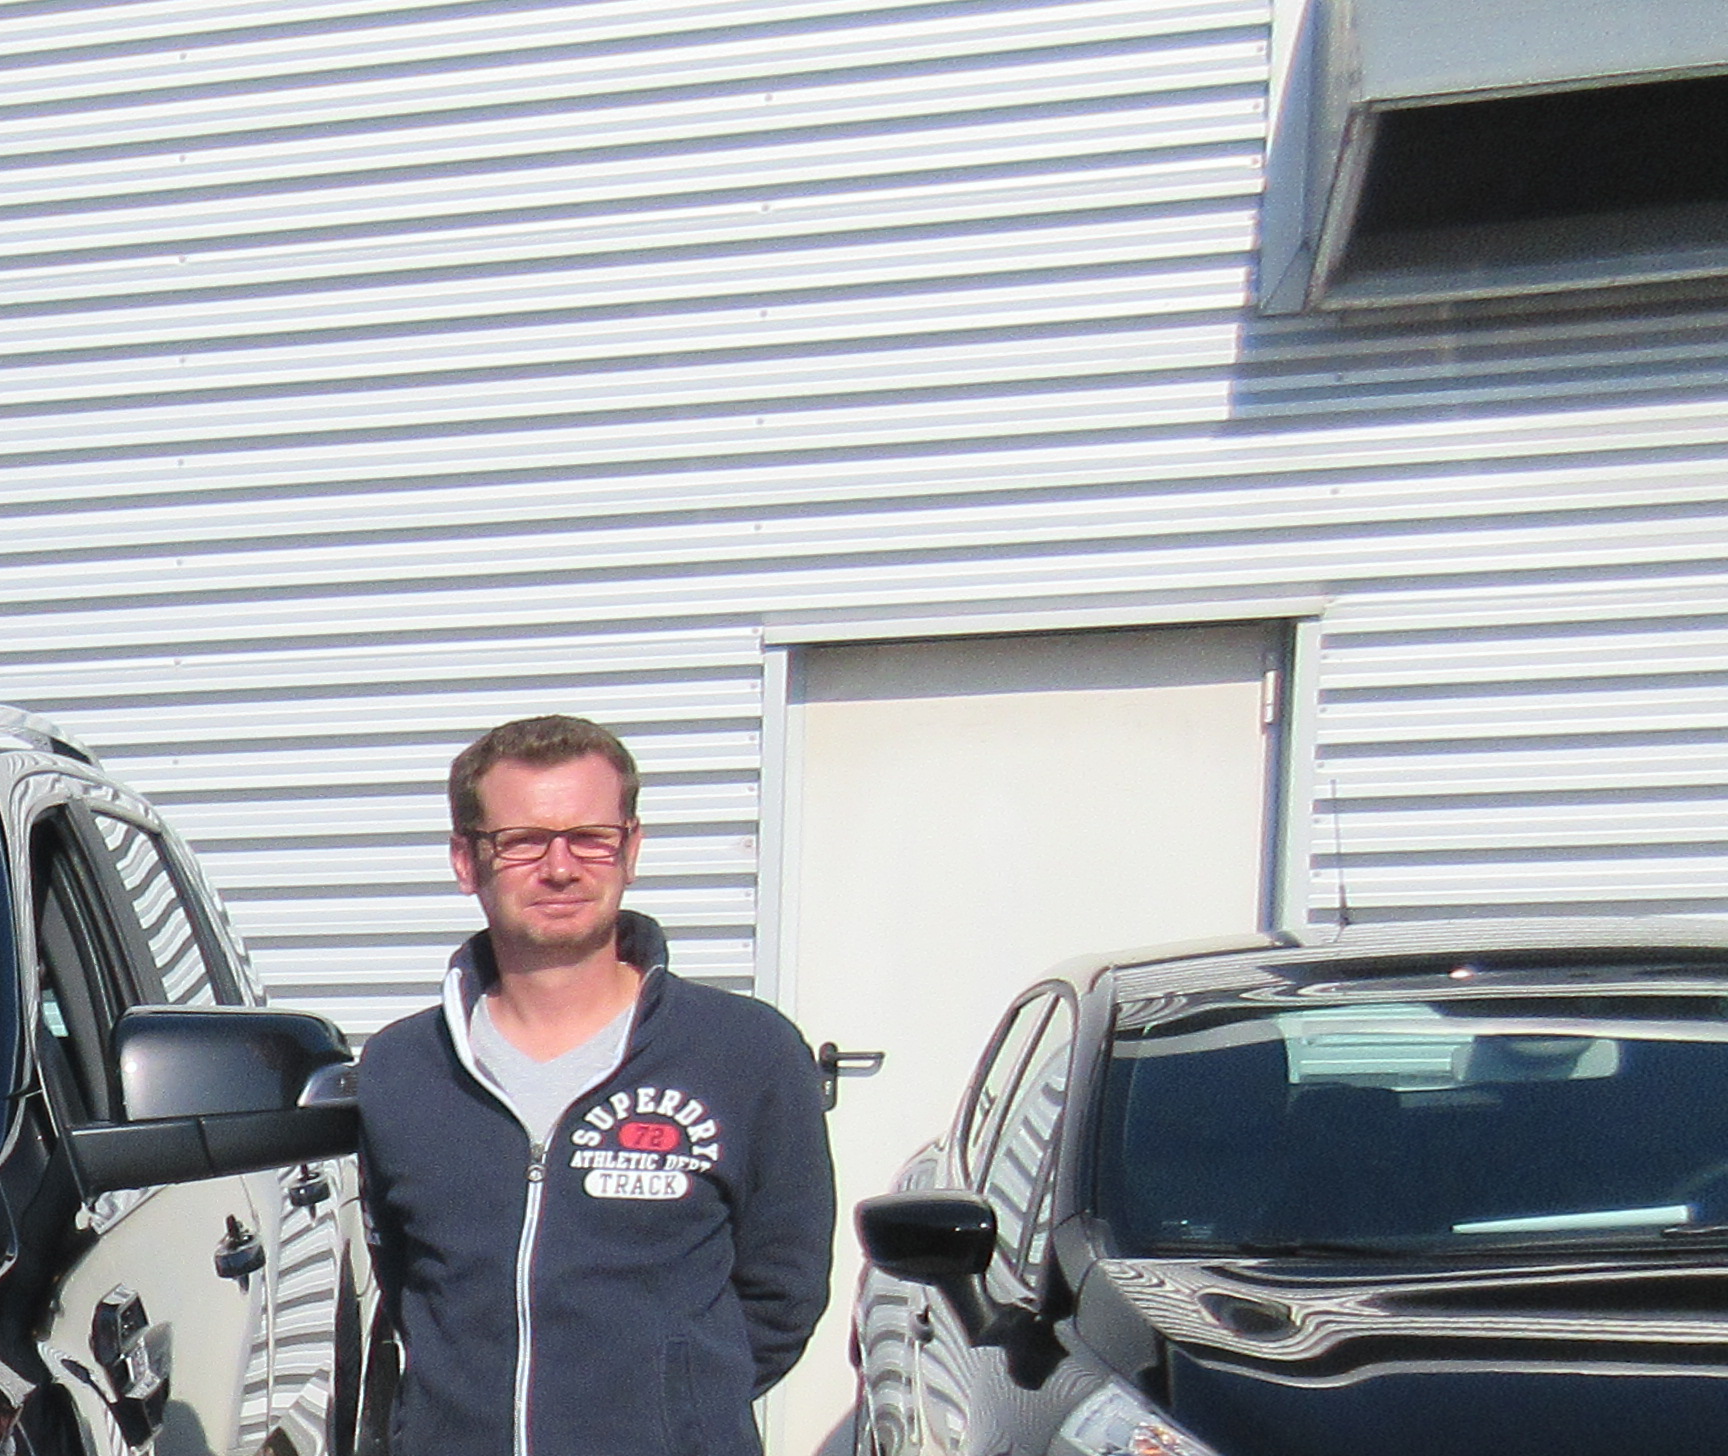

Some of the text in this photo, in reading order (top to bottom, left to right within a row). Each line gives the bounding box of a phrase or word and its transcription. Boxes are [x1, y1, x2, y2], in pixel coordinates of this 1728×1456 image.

[571, 1087, 719, 1161] SUPERDRY
[636, 1125, 662, 1147] 72
[569, 1150, 658, 1170] ATHLETIC
[598, 1174, 678, 1195] TRACK
